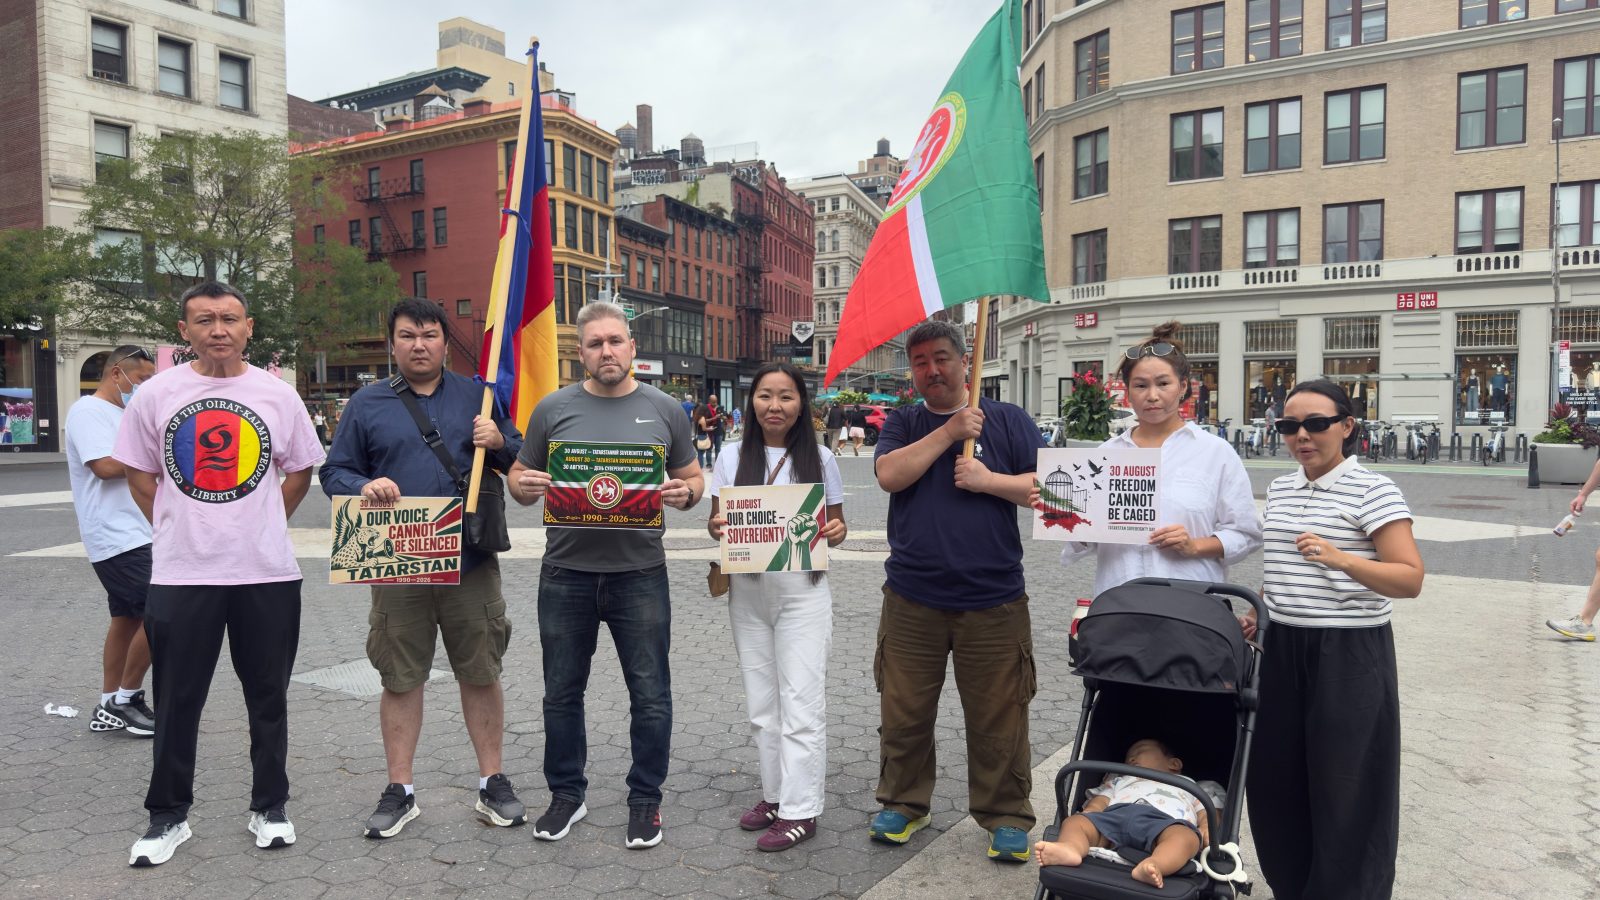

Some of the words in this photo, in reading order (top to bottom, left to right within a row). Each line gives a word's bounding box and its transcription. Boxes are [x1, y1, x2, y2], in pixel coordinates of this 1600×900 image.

[180, 403, 204, 417] THE
[169, 417, 181, 431] OF
[206, 400, 270, 449] OIRAT-KALMYK
[165, 432, 183, 484] CONGRESS
[247, 452, 269, 488] PEOPLE
[1109, 465, 1120, 476] 30
[1123, 465, 1156, 476] AUGUST
[1109, 479, 1156, 492] FREEDOM
[191, 488, 238, 501] LIBERTY
[1108, 493, 1154, 507] CANNOT
[360, 499, 369, 507] 30
[370, 499, 395, 507] AUGUST
[726, 500, 735, 510] 30
[736, 499, 761, 509] AUGUST
[366, 511, 391, 526] OUR
[394, 508, 429, 524] VOICE
[727, 511, 744, 526] OUR
[746, 510, 777, 525] CHOICE
[1108, 508, 1120, 520] BE
[1123, 508, 1156, 521] CAGED
[388, 522, 436, 540] CANNOT
[727, 526, 786, 544] SOVEREIGNTY
[394, 538, 407, 552] BE
[408, 536, 458, 551] SILENCED
[347, 558, 458, 581] TATARSTAN
